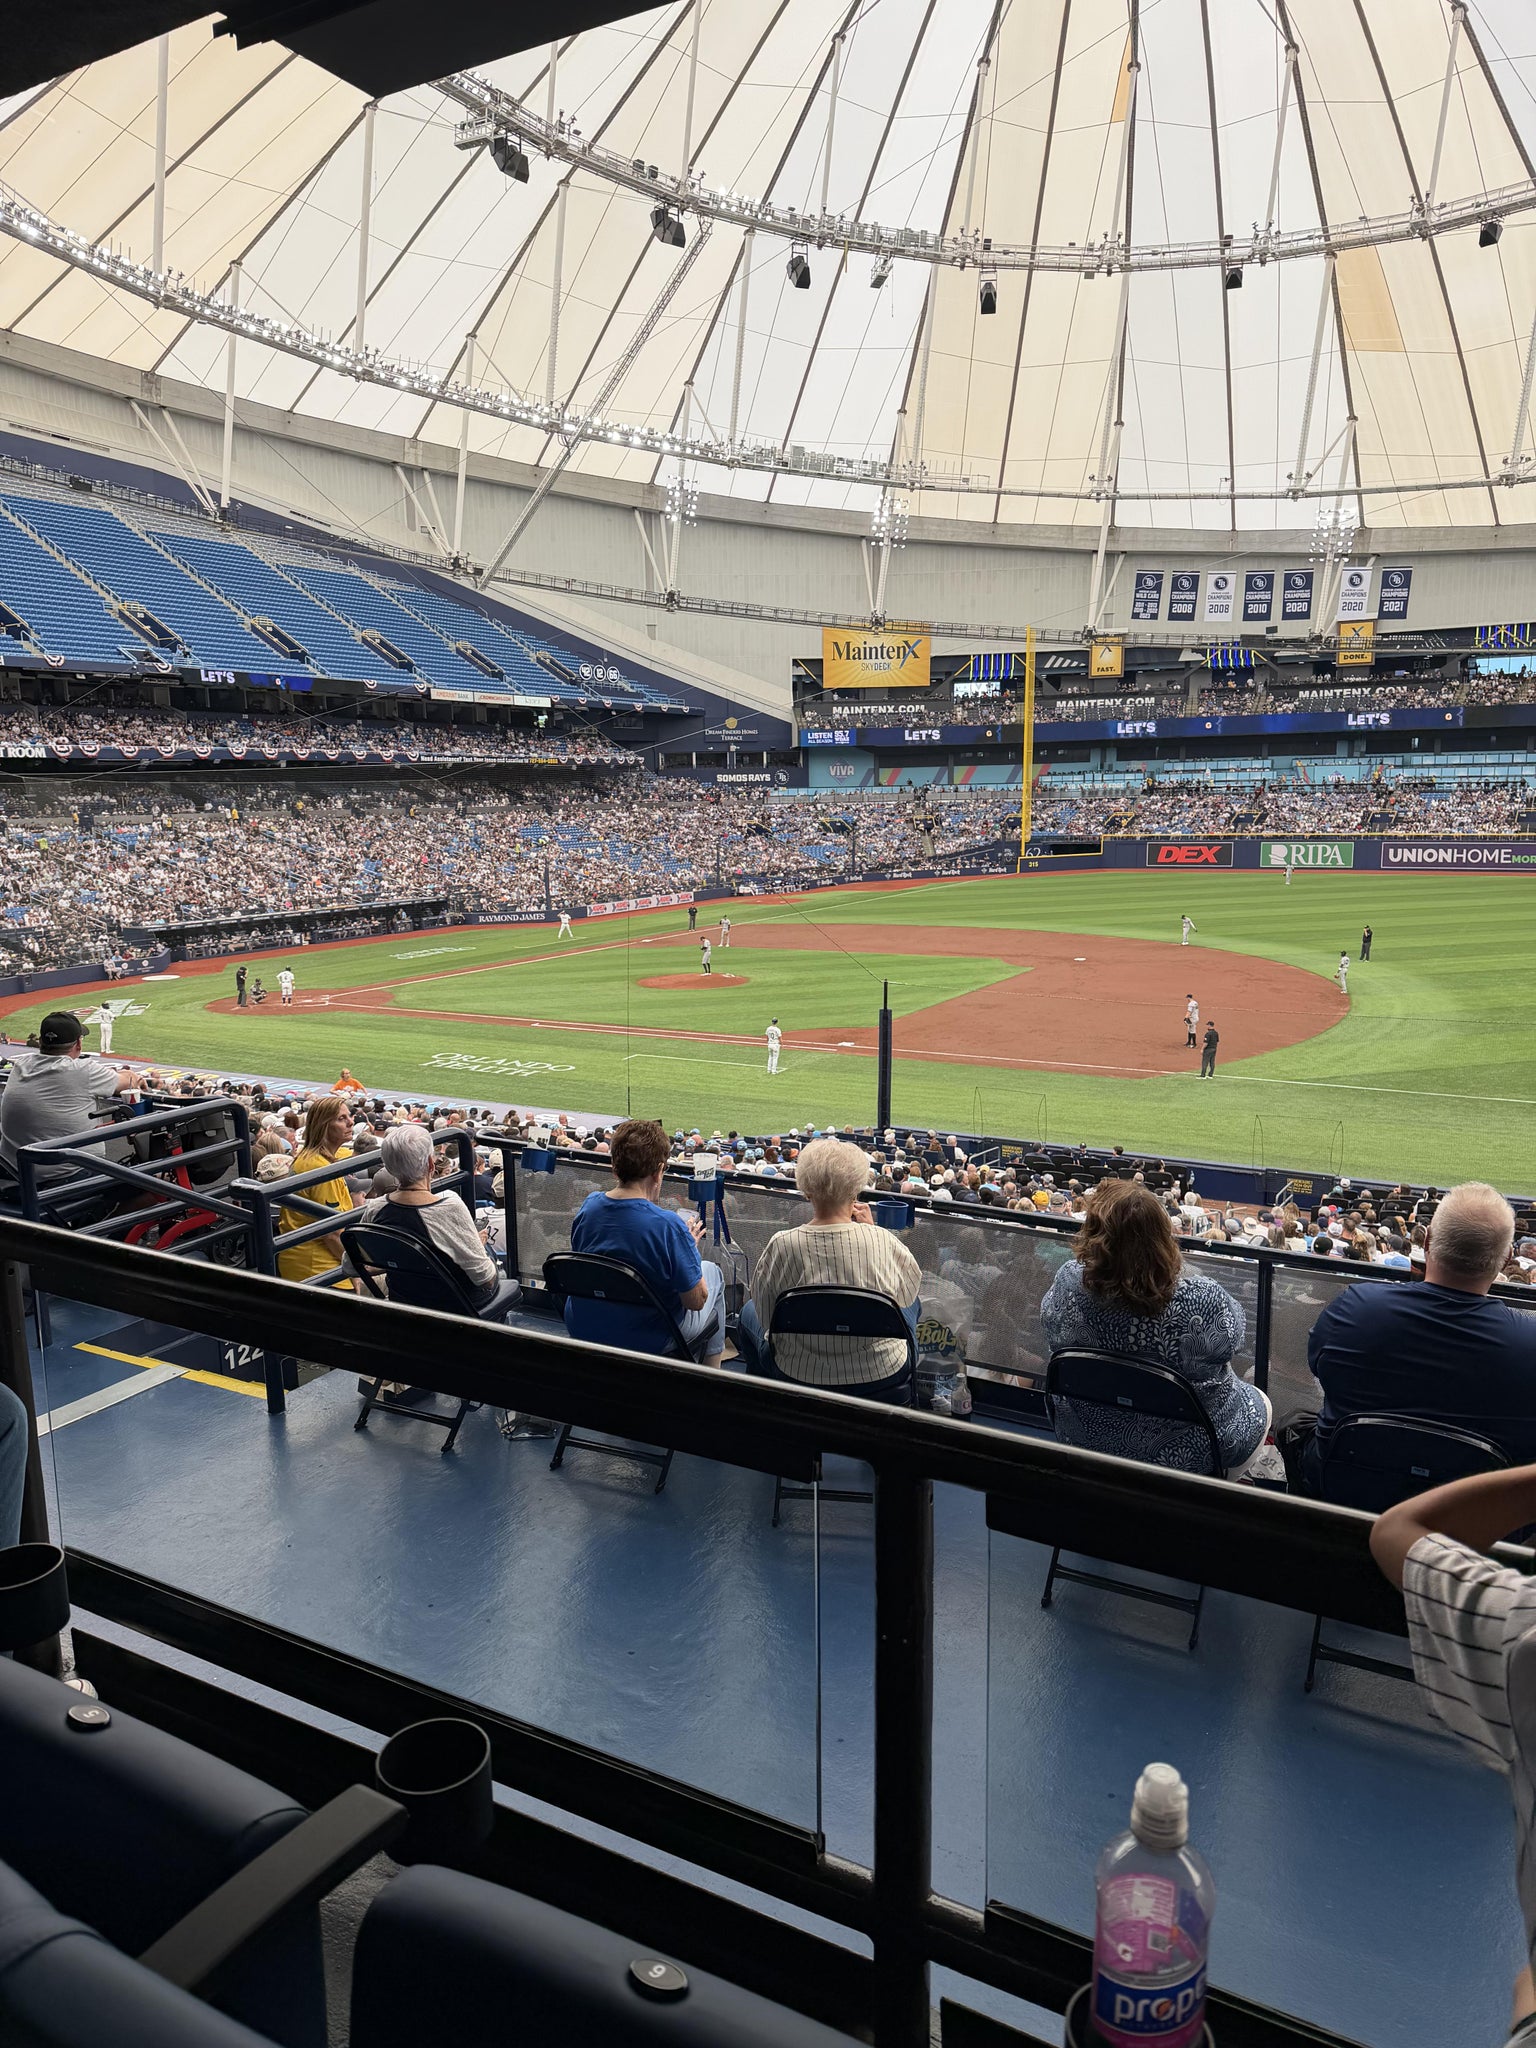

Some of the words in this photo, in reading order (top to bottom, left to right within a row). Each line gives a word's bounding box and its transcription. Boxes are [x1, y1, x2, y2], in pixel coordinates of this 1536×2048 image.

[1172, 603, 1192, 614] 2008
[1208, 604, 1230, 614] 2008
[1247, 603, 1267, 614] 2010
[1286, 602, 1308, 612] 2020
[1342, 601, 1364, 611] 2020
[1383, 601, 1404, 612] 2021
[832, 639, 922, 669] MaintenX
[861, 662, 892, 671] SKYDECK
[1413, 659, 1431, 669] EATS
[200, 669, 236, 683] LET'S
[1347, 713, 1391, 726] LET'S
[1116, 721, 1156, 734] LET'S
[807, 732, 833, 740] LISTEN
[904, 729, 941, 741] LET'S
[7, 746, 47, 758] ROOM
[716, 774, 748, 782] SOMOS
[748, 773, 771, 782] RAYS
[1157, 845, 1222, 864] DEX
[1290, 844, 1345, 865] RIPA
[478, 914, 519, 922] RAYMOND
[431, 1052, 576, 1072] ORLANDO
[418, 1059, 542, 1077] HEALTH
[926, 1200, 933, 1208] 3
[1205, 1239, 1213, 1248] 4
[224, 1344, 264, 1370] 122
